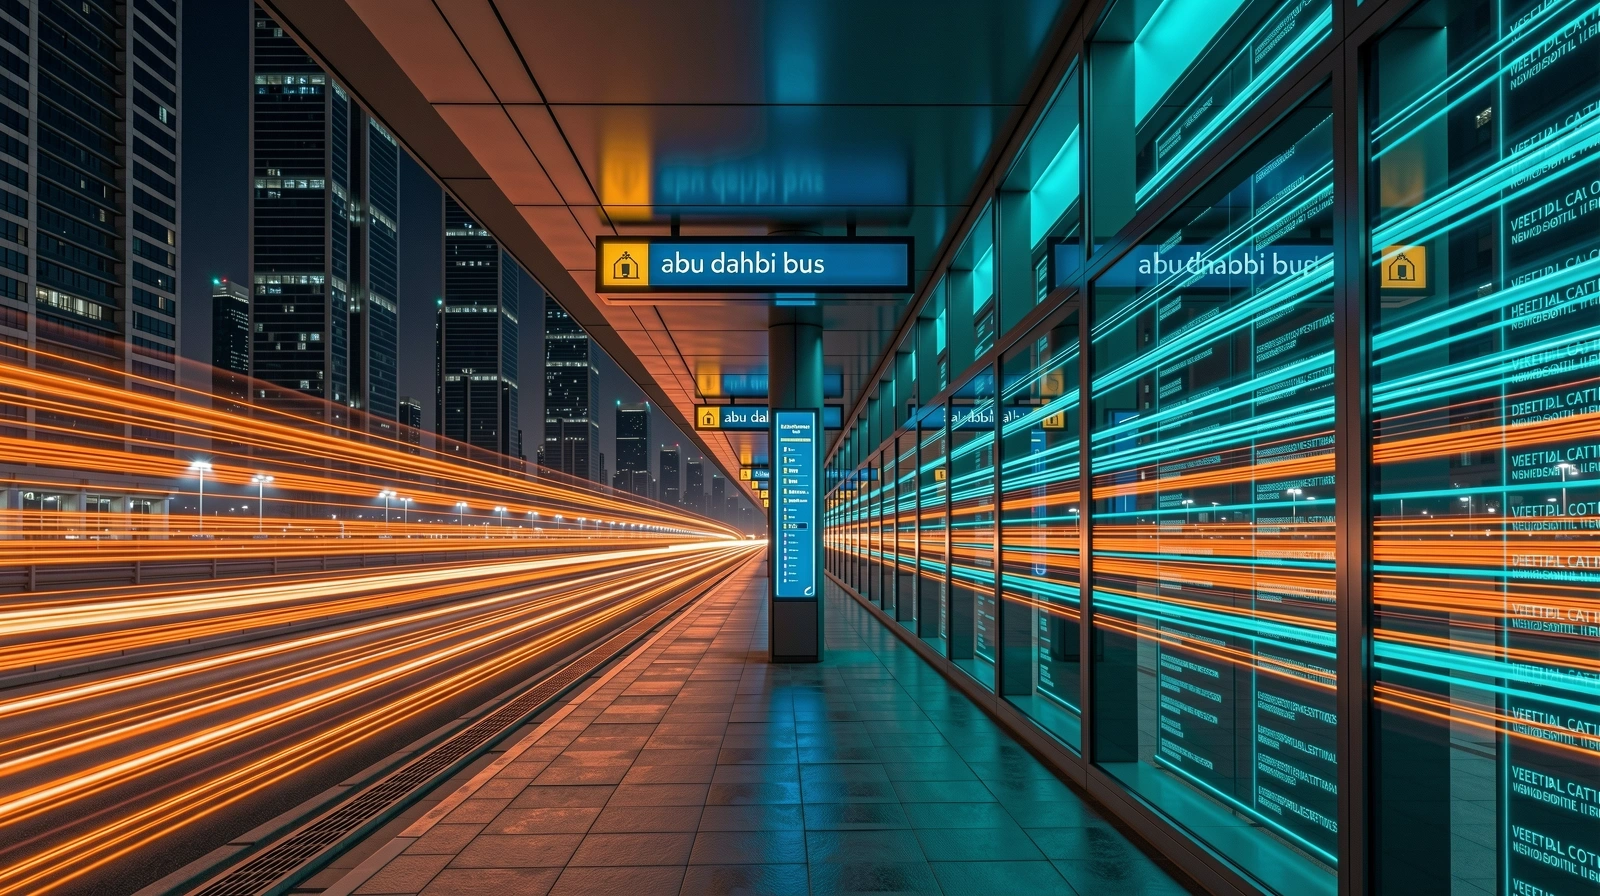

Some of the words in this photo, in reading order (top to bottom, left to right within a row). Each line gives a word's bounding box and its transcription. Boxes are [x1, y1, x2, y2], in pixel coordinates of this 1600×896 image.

[661, 251, 704, 274] abu
[711, 251, 776, 274] dahbi
[783, 251, 825, 274] bus
[724, 410, 747, 423] abu
